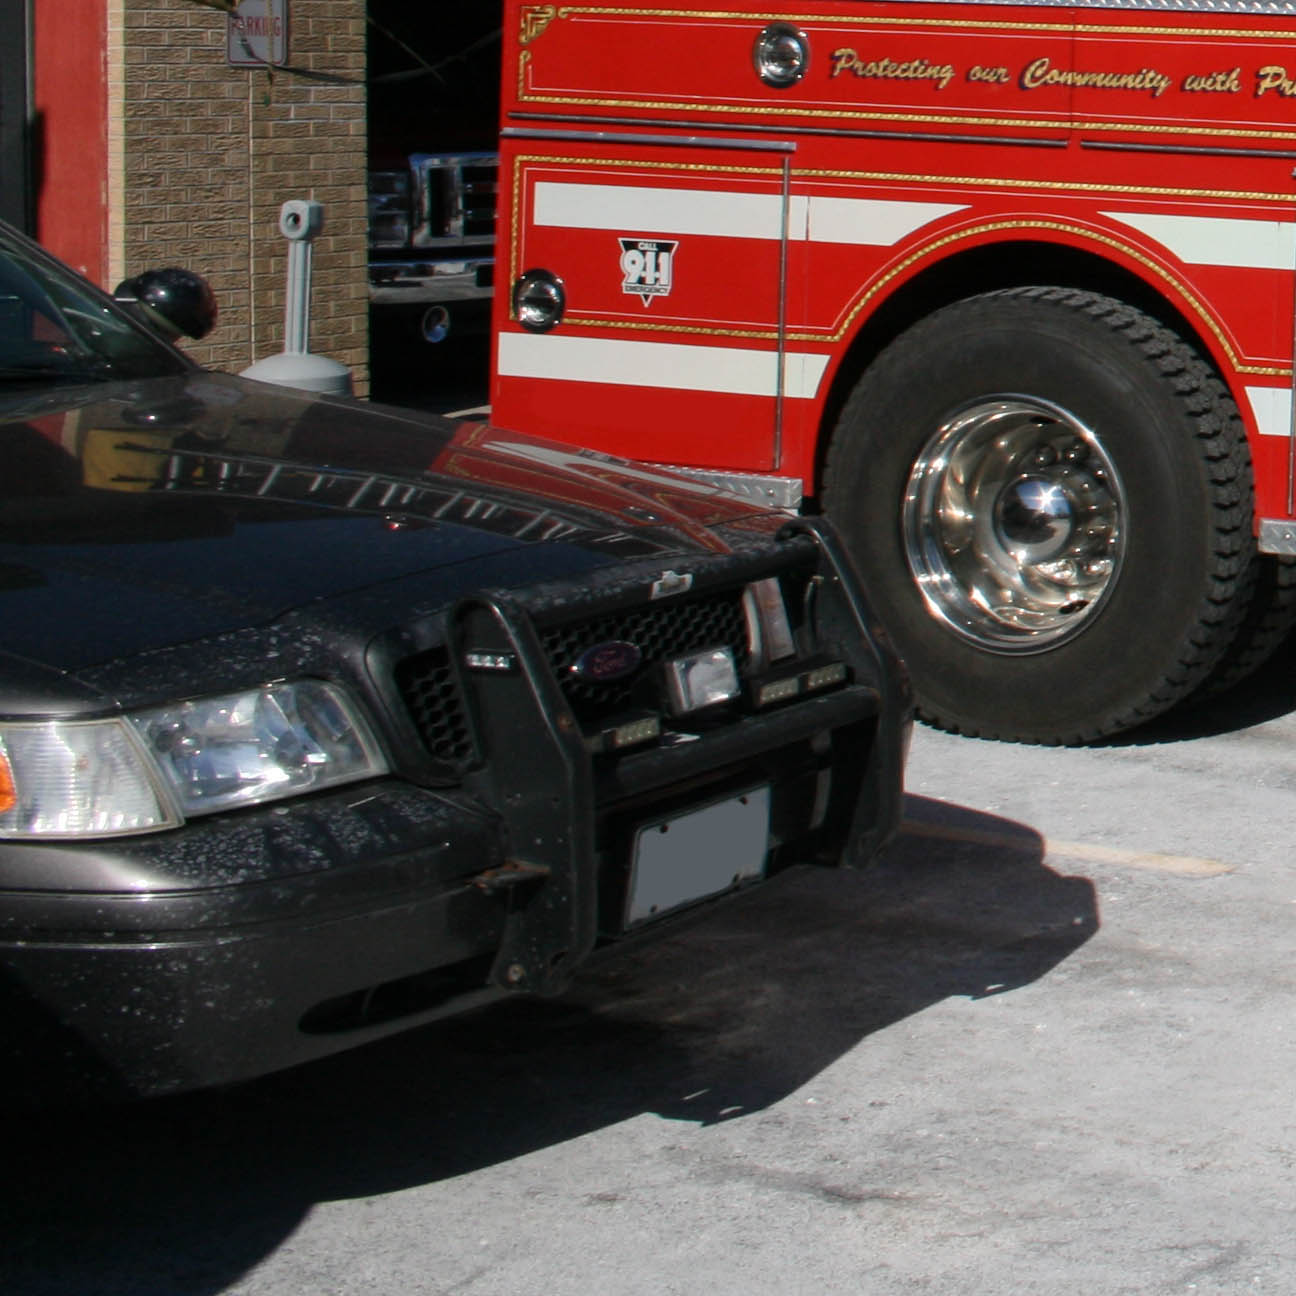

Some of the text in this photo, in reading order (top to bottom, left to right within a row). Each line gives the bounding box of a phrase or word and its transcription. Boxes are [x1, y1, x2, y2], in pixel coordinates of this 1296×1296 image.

[831, 48, 954, 89] Protecting
[966, 65, 1011, 84] our
[1018, 57, 1171, 98] Community
[1180, 67, 1241, 93] with
